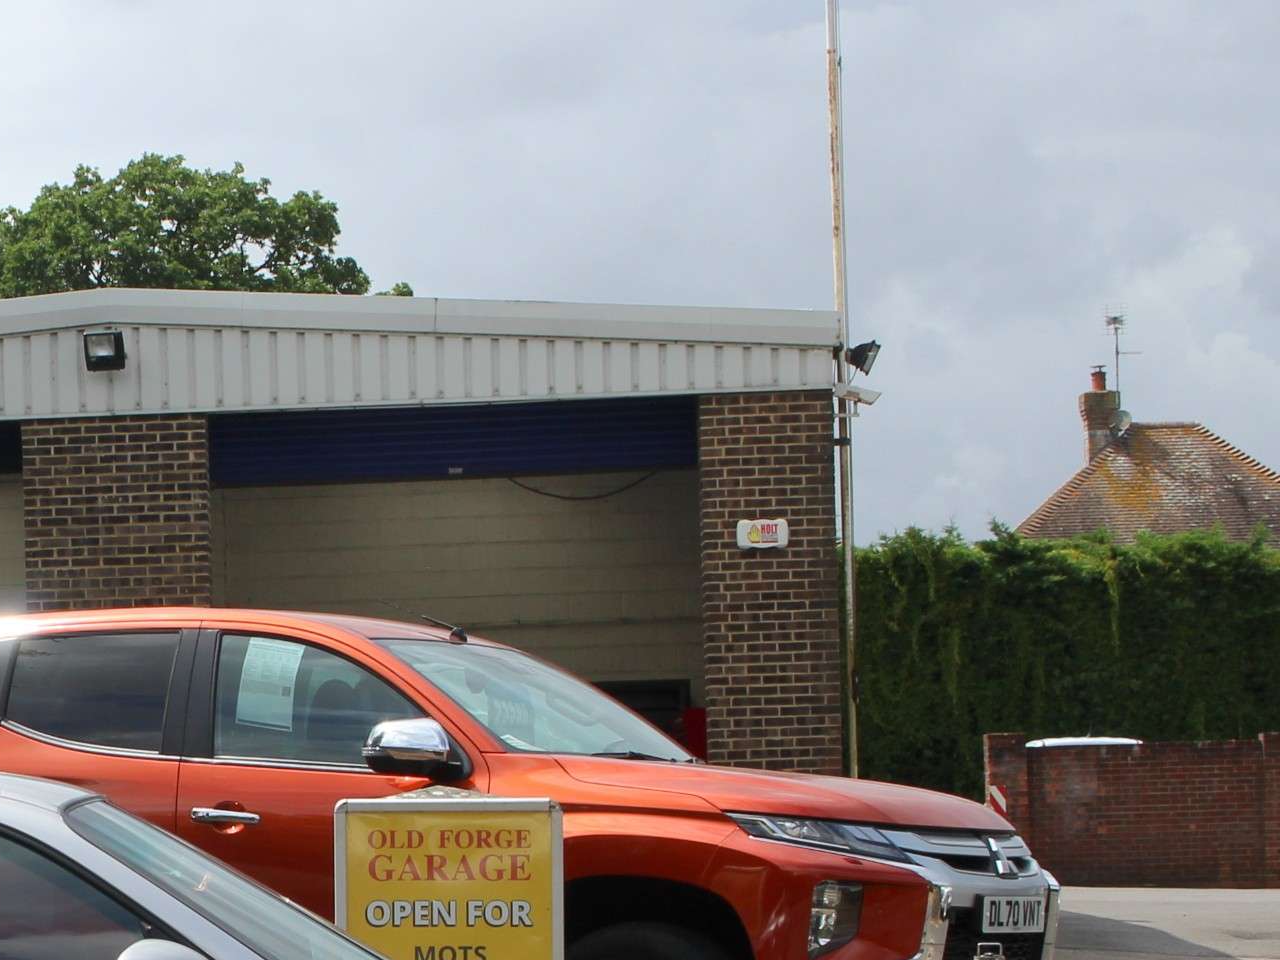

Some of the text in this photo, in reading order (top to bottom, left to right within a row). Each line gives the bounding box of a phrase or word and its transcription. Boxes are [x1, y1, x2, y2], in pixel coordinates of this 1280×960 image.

[761, 523, 778, 535] HOLT
[368, 829, 532, 849] OLD FORGE
[368, 854, 532, 881] GARAGE
[365, 899, 533, 927] OPEN FOR
[989, 900, 1041, 927] DL70 VNT
